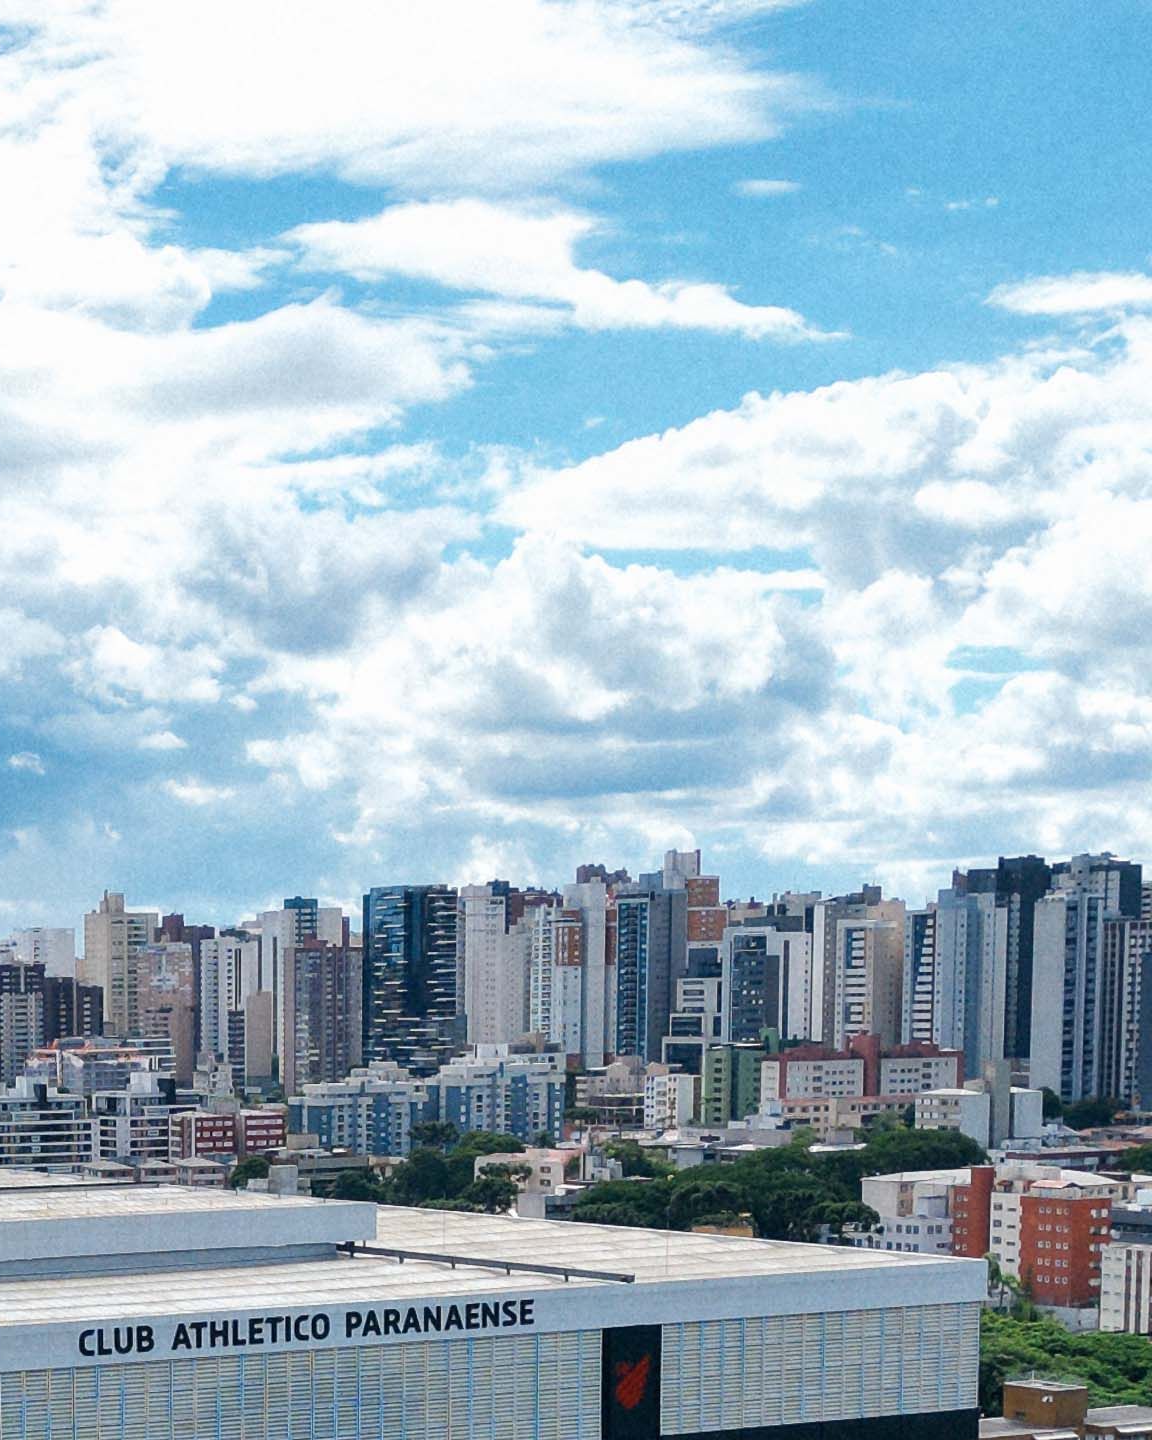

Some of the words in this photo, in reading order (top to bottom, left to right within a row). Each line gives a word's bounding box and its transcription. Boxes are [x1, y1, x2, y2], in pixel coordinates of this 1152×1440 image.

[79, 1326, 154, 1356] CLUB
[172, 1313, 330, 1350] ATHLETICO
[346, 1300, 534, 1337] PARANAENSE
